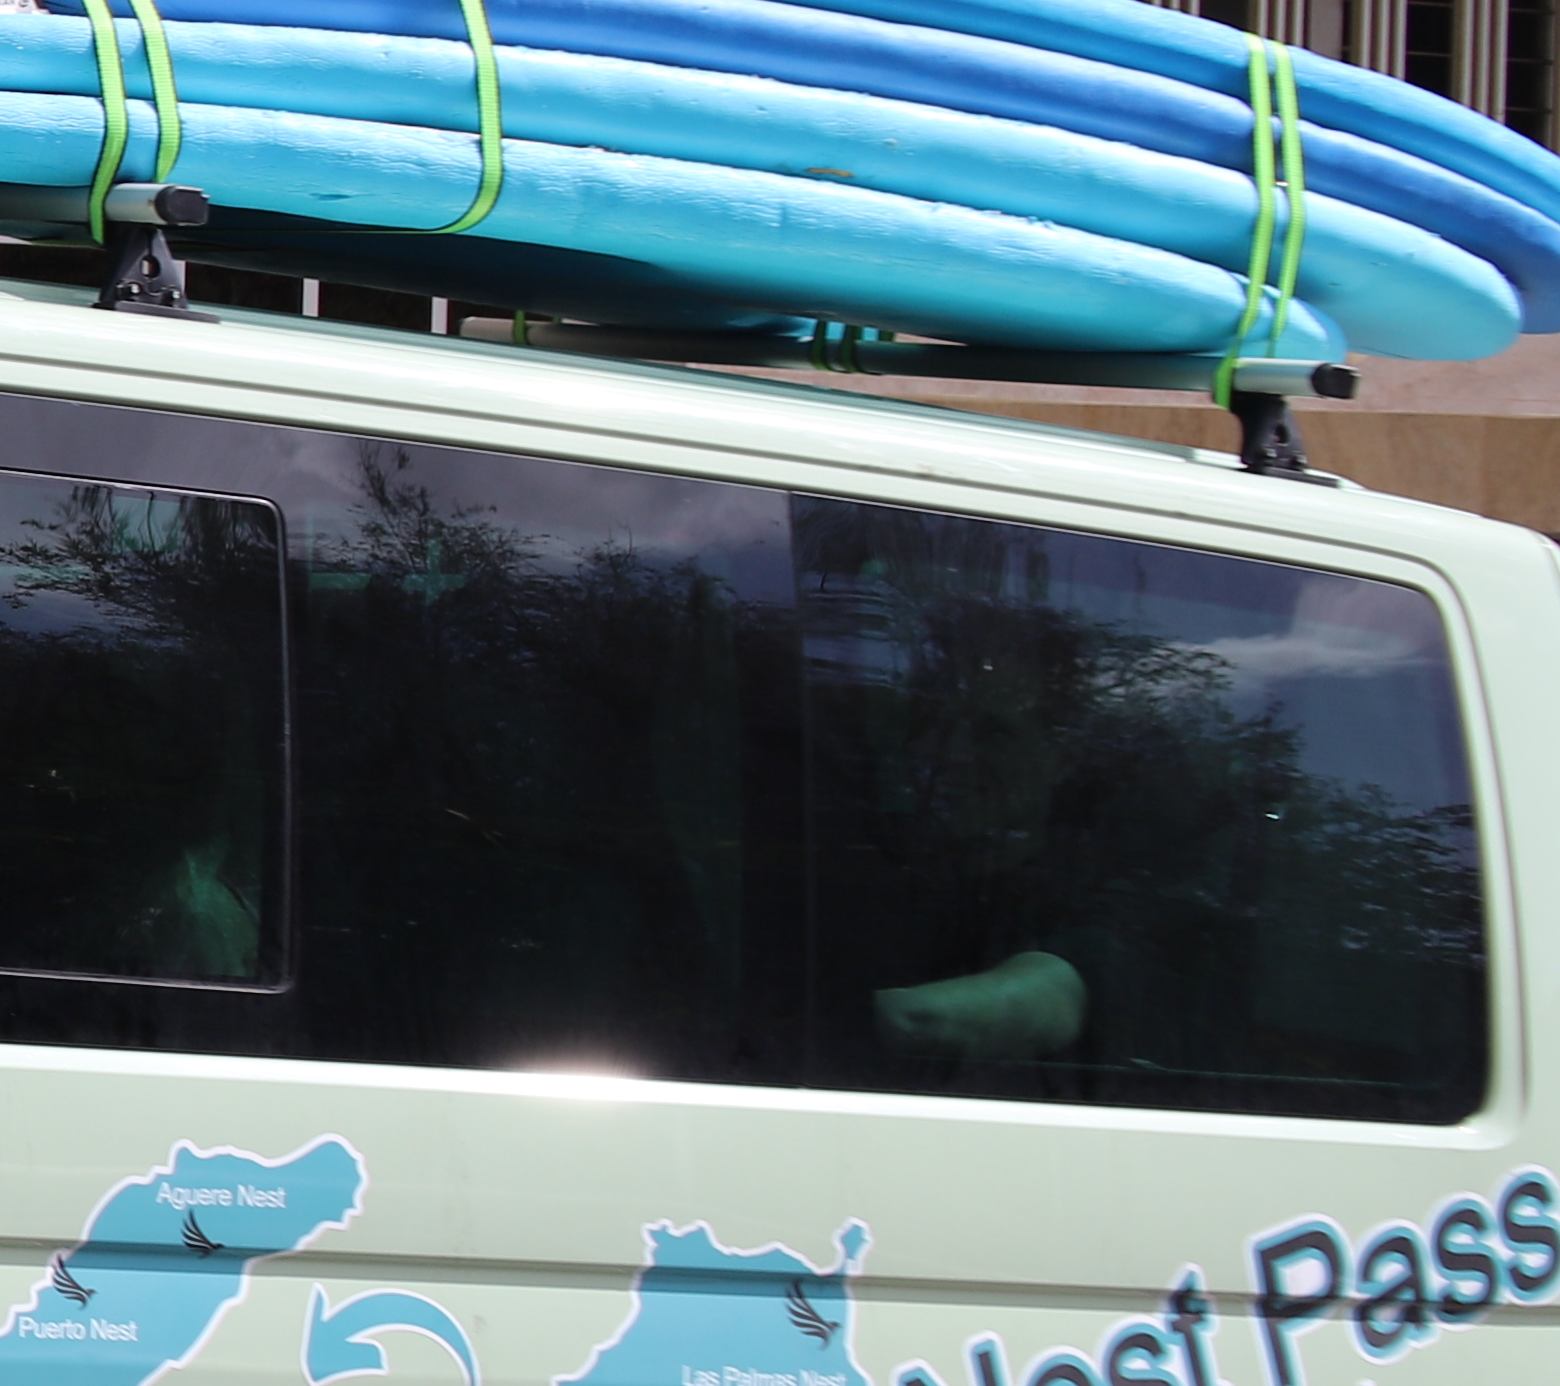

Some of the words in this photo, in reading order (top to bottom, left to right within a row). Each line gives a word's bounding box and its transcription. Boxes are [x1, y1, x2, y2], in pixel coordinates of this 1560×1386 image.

[156, 1182, 233, 1211] Aguere
[237, 1184, 287, 1208] Nest
[18, 1316, 86, 1341] Puerto
[90, 1318, 139, 1342] Nest
